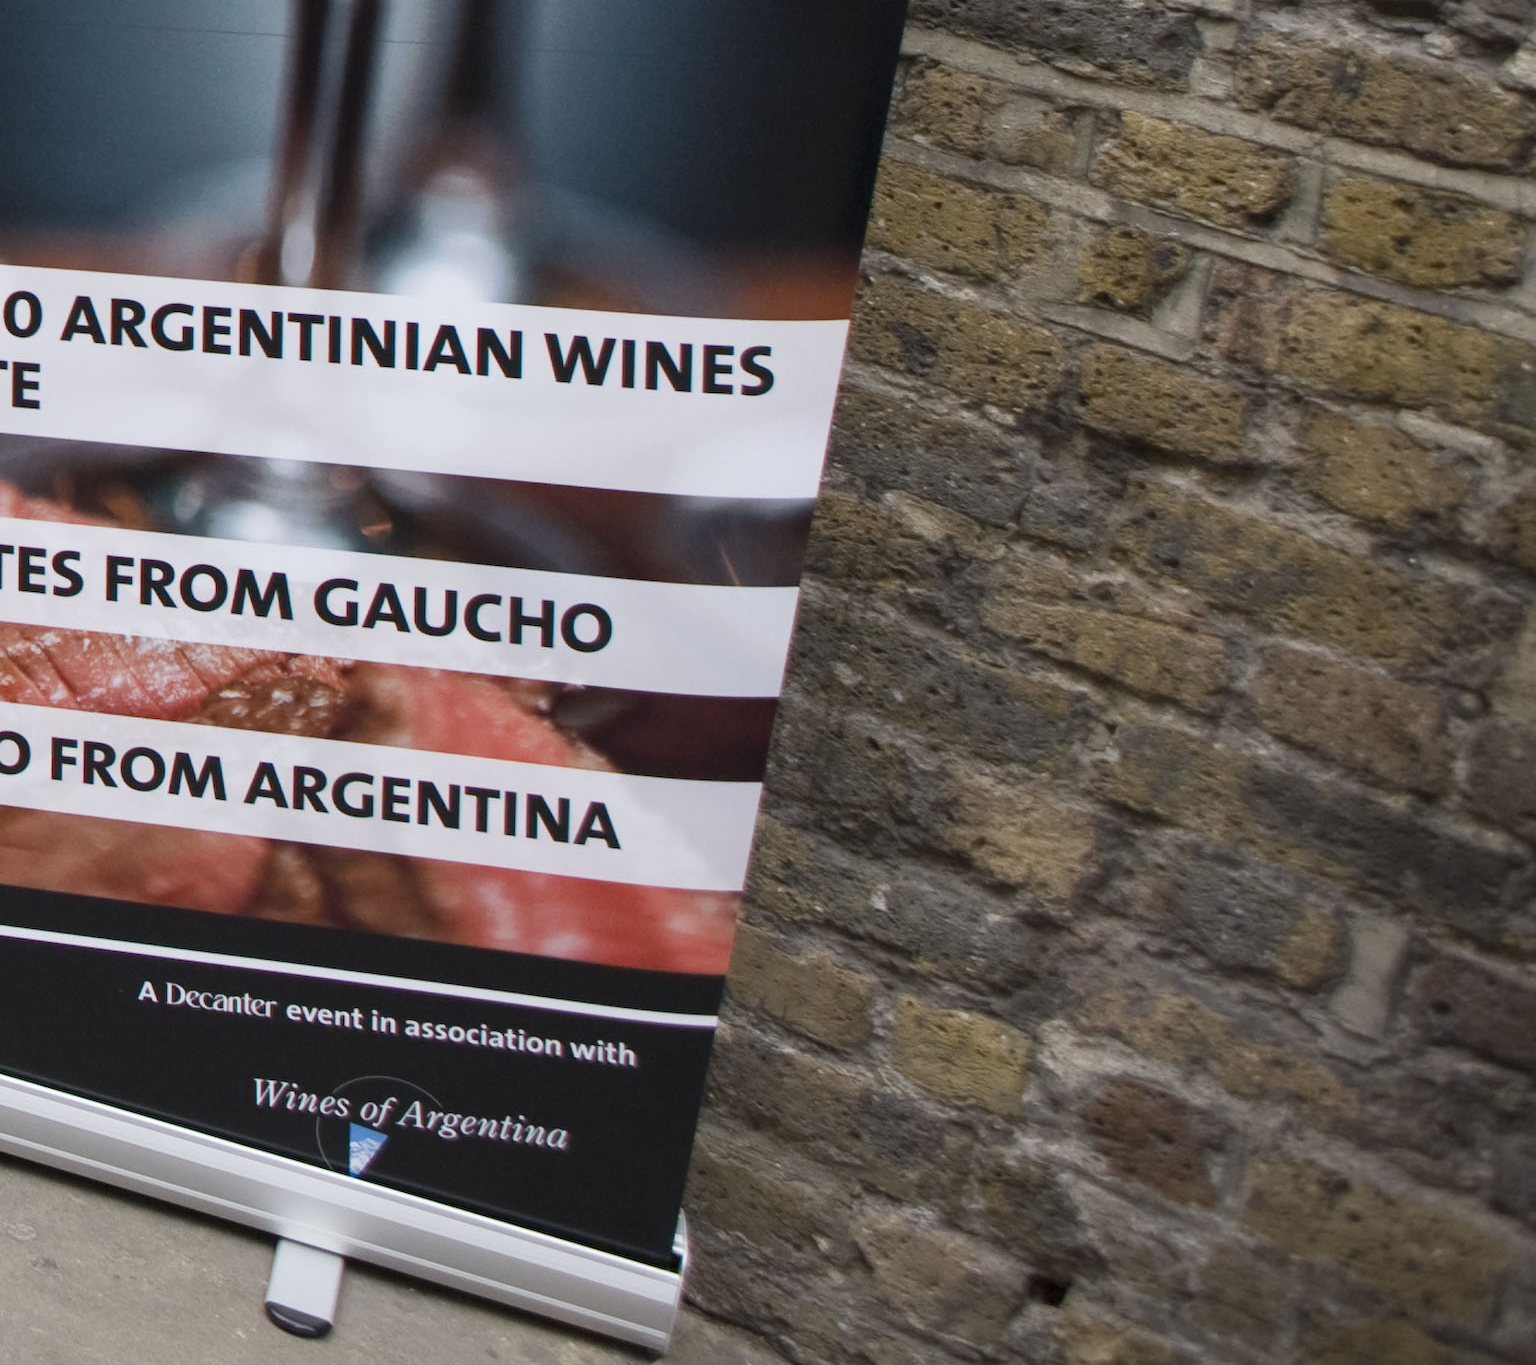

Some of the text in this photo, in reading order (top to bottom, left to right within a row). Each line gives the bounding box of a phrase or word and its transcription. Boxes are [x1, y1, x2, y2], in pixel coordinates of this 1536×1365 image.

[60, 295, 524, 381] ARGENTINIAN
[544, 332, 776, 398] WINES
[105, 554, 294, 621] FROM
[313, 576, 614, 654] GAUCHO
[50, 736, 228, 802] FROM
[243, 760, 622, 850] ARGENTINA
[138, 980, 638, 1068] A Decanter event in association with
[253, 1077, 571, 1151] Wines of Argentina
